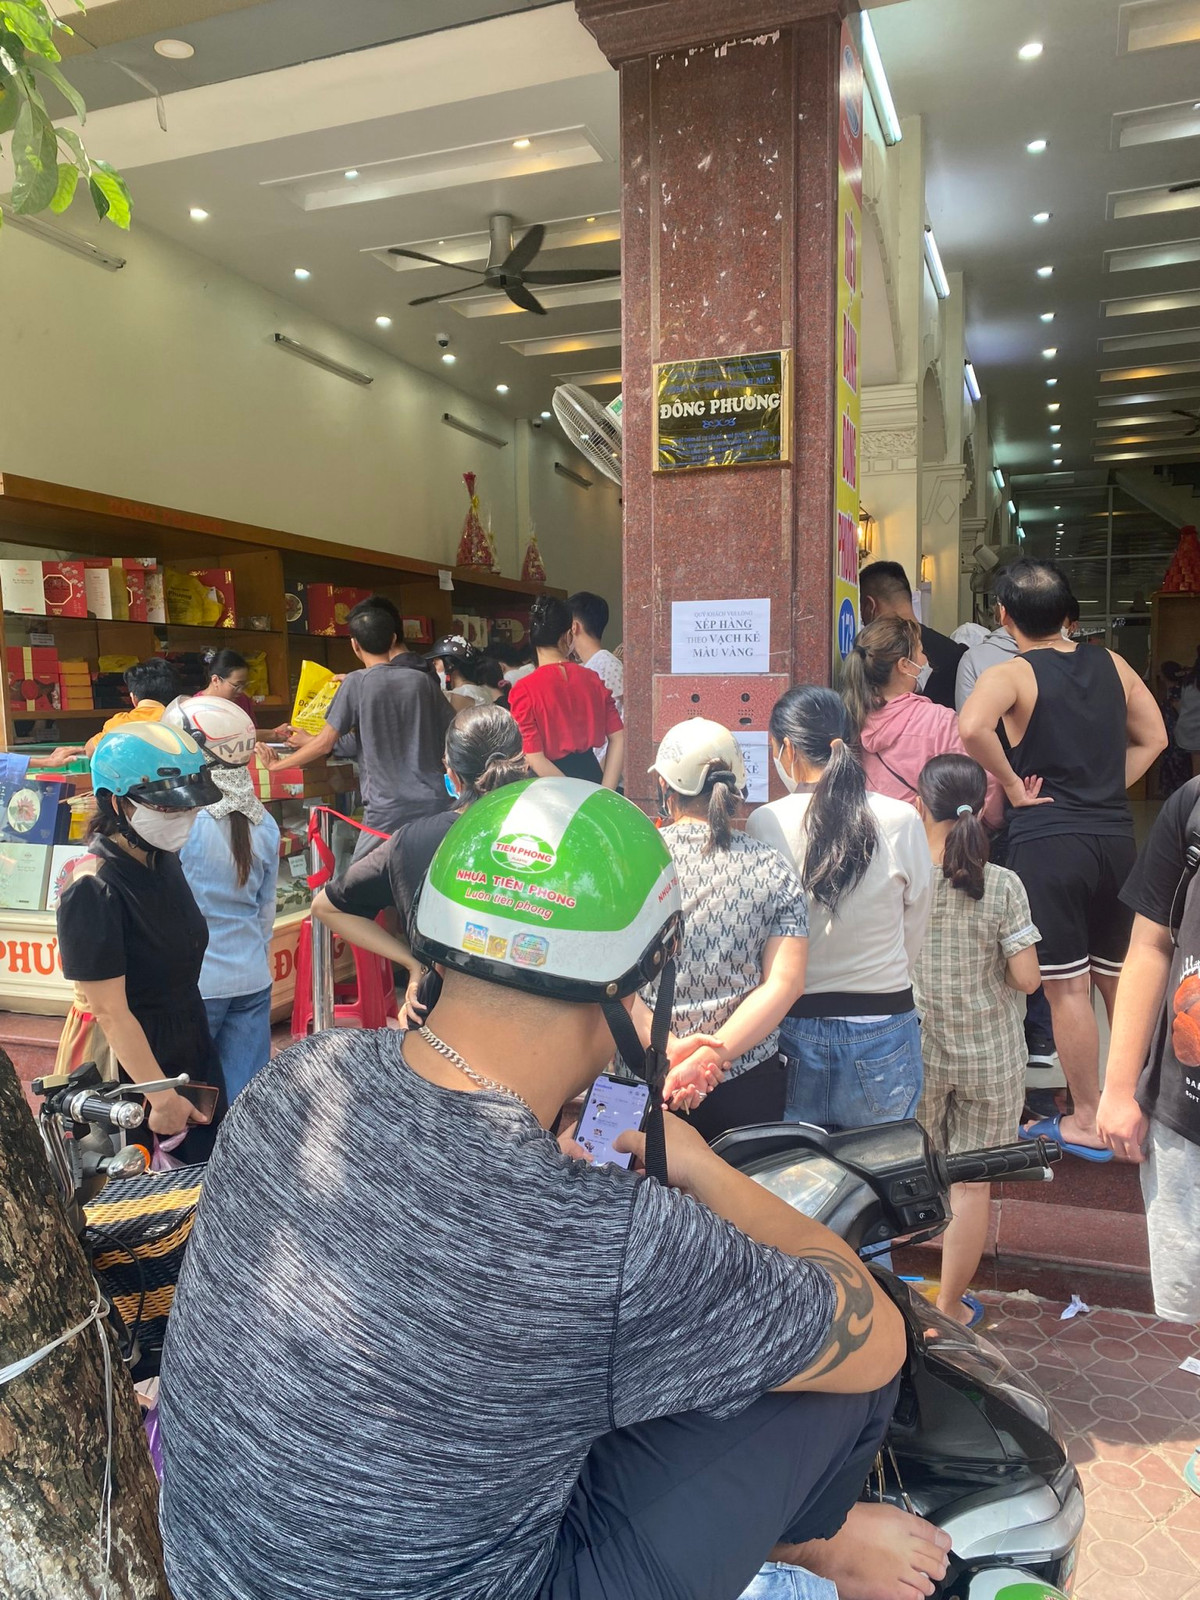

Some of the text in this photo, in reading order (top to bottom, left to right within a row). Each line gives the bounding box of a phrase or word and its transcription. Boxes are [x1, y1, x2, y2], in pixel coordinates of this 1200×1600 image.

[659, 392, 781, 420] ĐÔNG PHƯƠNG
[719, 616, 753, 629] HÀNG
[687, 636, 708, 644] THEO
[709, 633, 741, 646] VẠCH
[692, 645, 754, 658] MÀU VÀNG
[517, 847, 553, 863] PHONG
[528, 884, 576, 908] PHONG
[514, 899, 553, 920] phong
